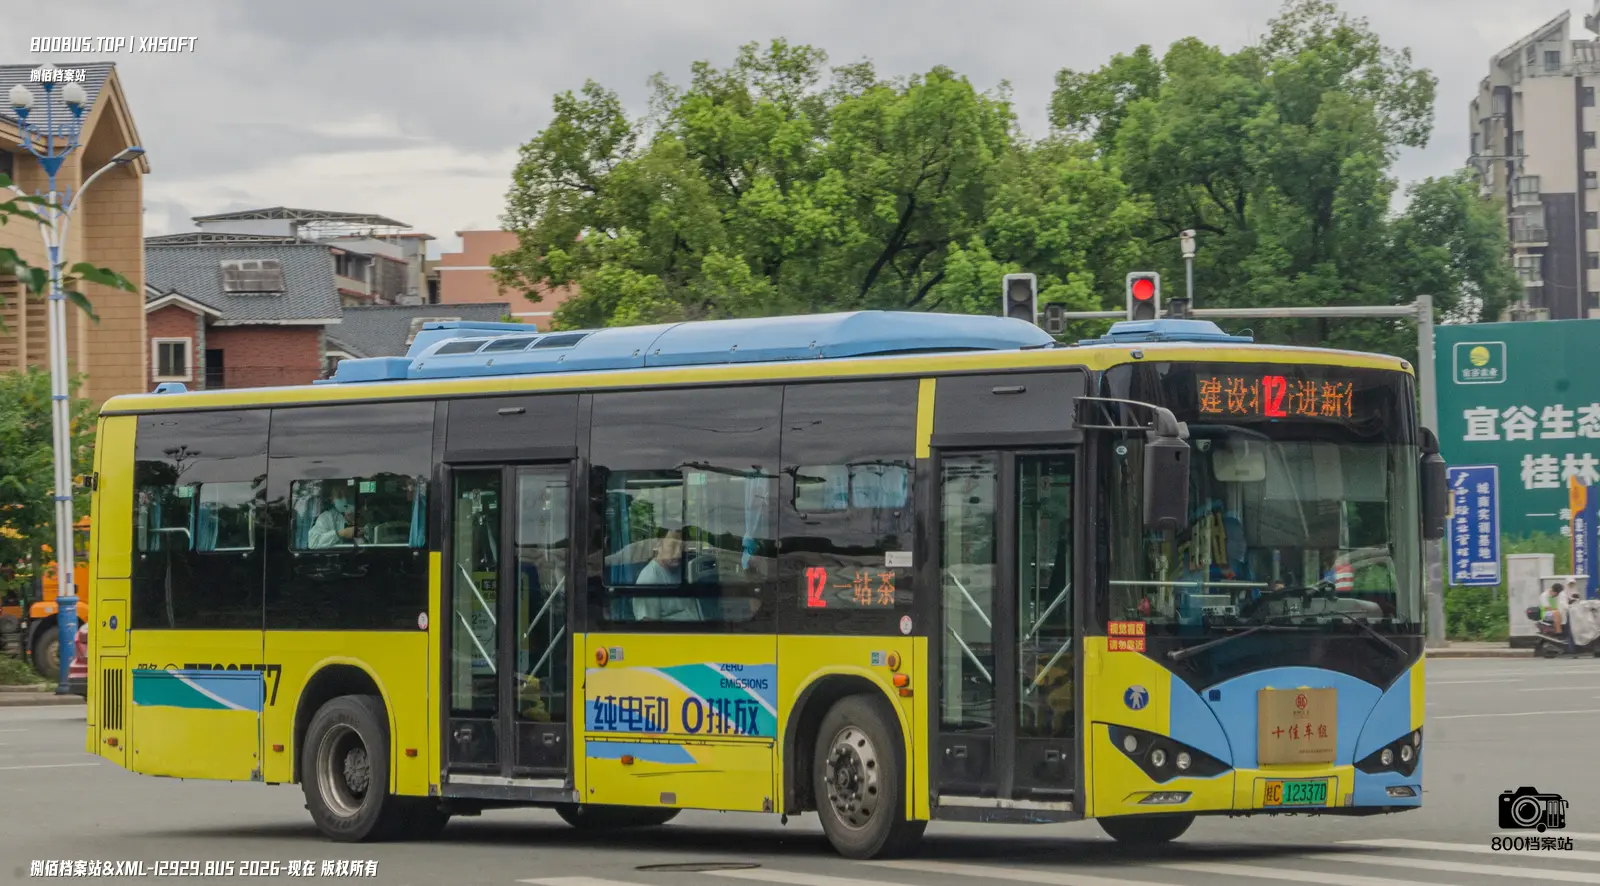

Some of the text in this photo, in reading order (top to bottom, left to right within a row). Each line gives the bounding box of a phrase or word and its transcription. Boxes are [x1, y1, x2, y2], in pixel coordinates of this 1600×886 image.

[1262, 375, 1287, 417] 12
[1463, 403, 1600, 441] 宜谷生态
[1520, 453, 1600, 489] 桂林
[805, 567, 827, 608] 12
[720, 678, 769, 690] EMISSIONS
[593, 695, 669, 732] 纯电动
[1271, 723, 1328, 741] 十佳车组
